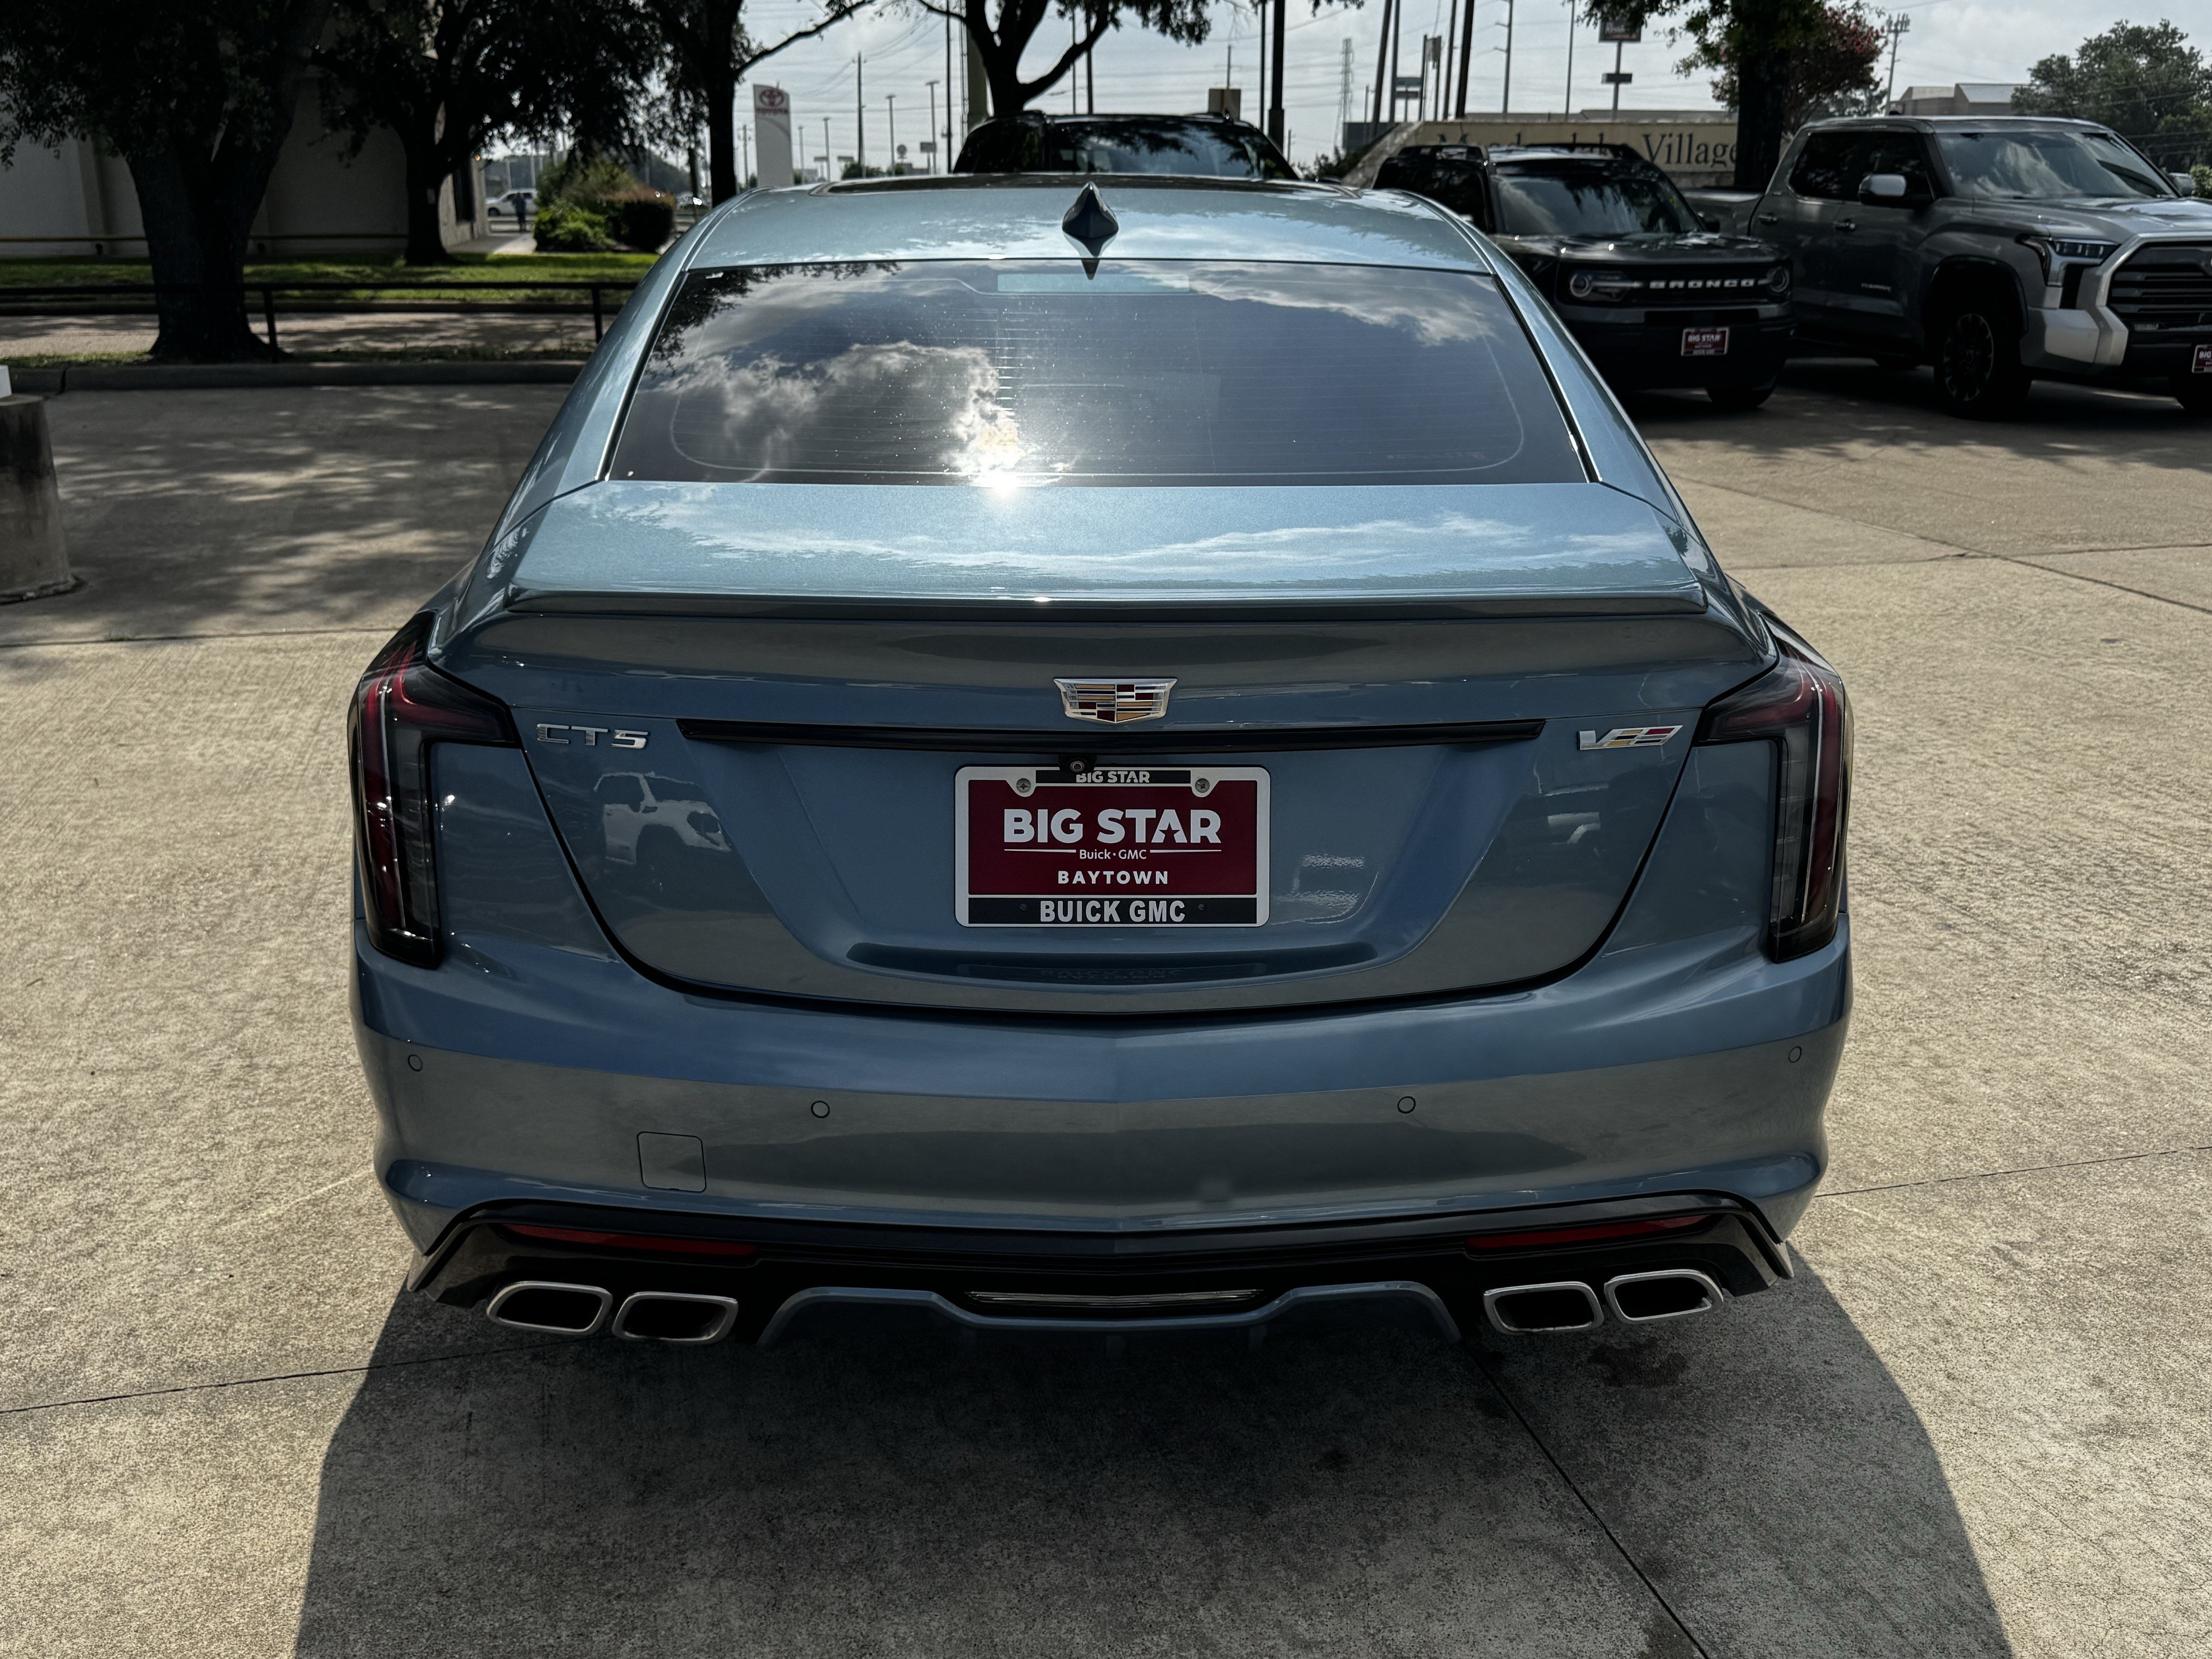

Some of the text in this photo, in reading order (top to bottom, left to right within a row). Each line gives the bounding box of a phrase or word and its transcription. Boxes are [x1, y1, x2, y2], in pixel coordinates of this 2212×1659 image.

[1642, 133, 1736, 168] Village
[1649, 278, 1755, 289] BRONCO
[537, 723, 649, 749] CT5
[1076, 771, 1150, 783] BIG STAR
[1004, 808, 1222, 844] BIG STAR
[1058, 870, 1168, 884] BAYTOWN
[1040, 900, 1185, 922] BUICK GMC
